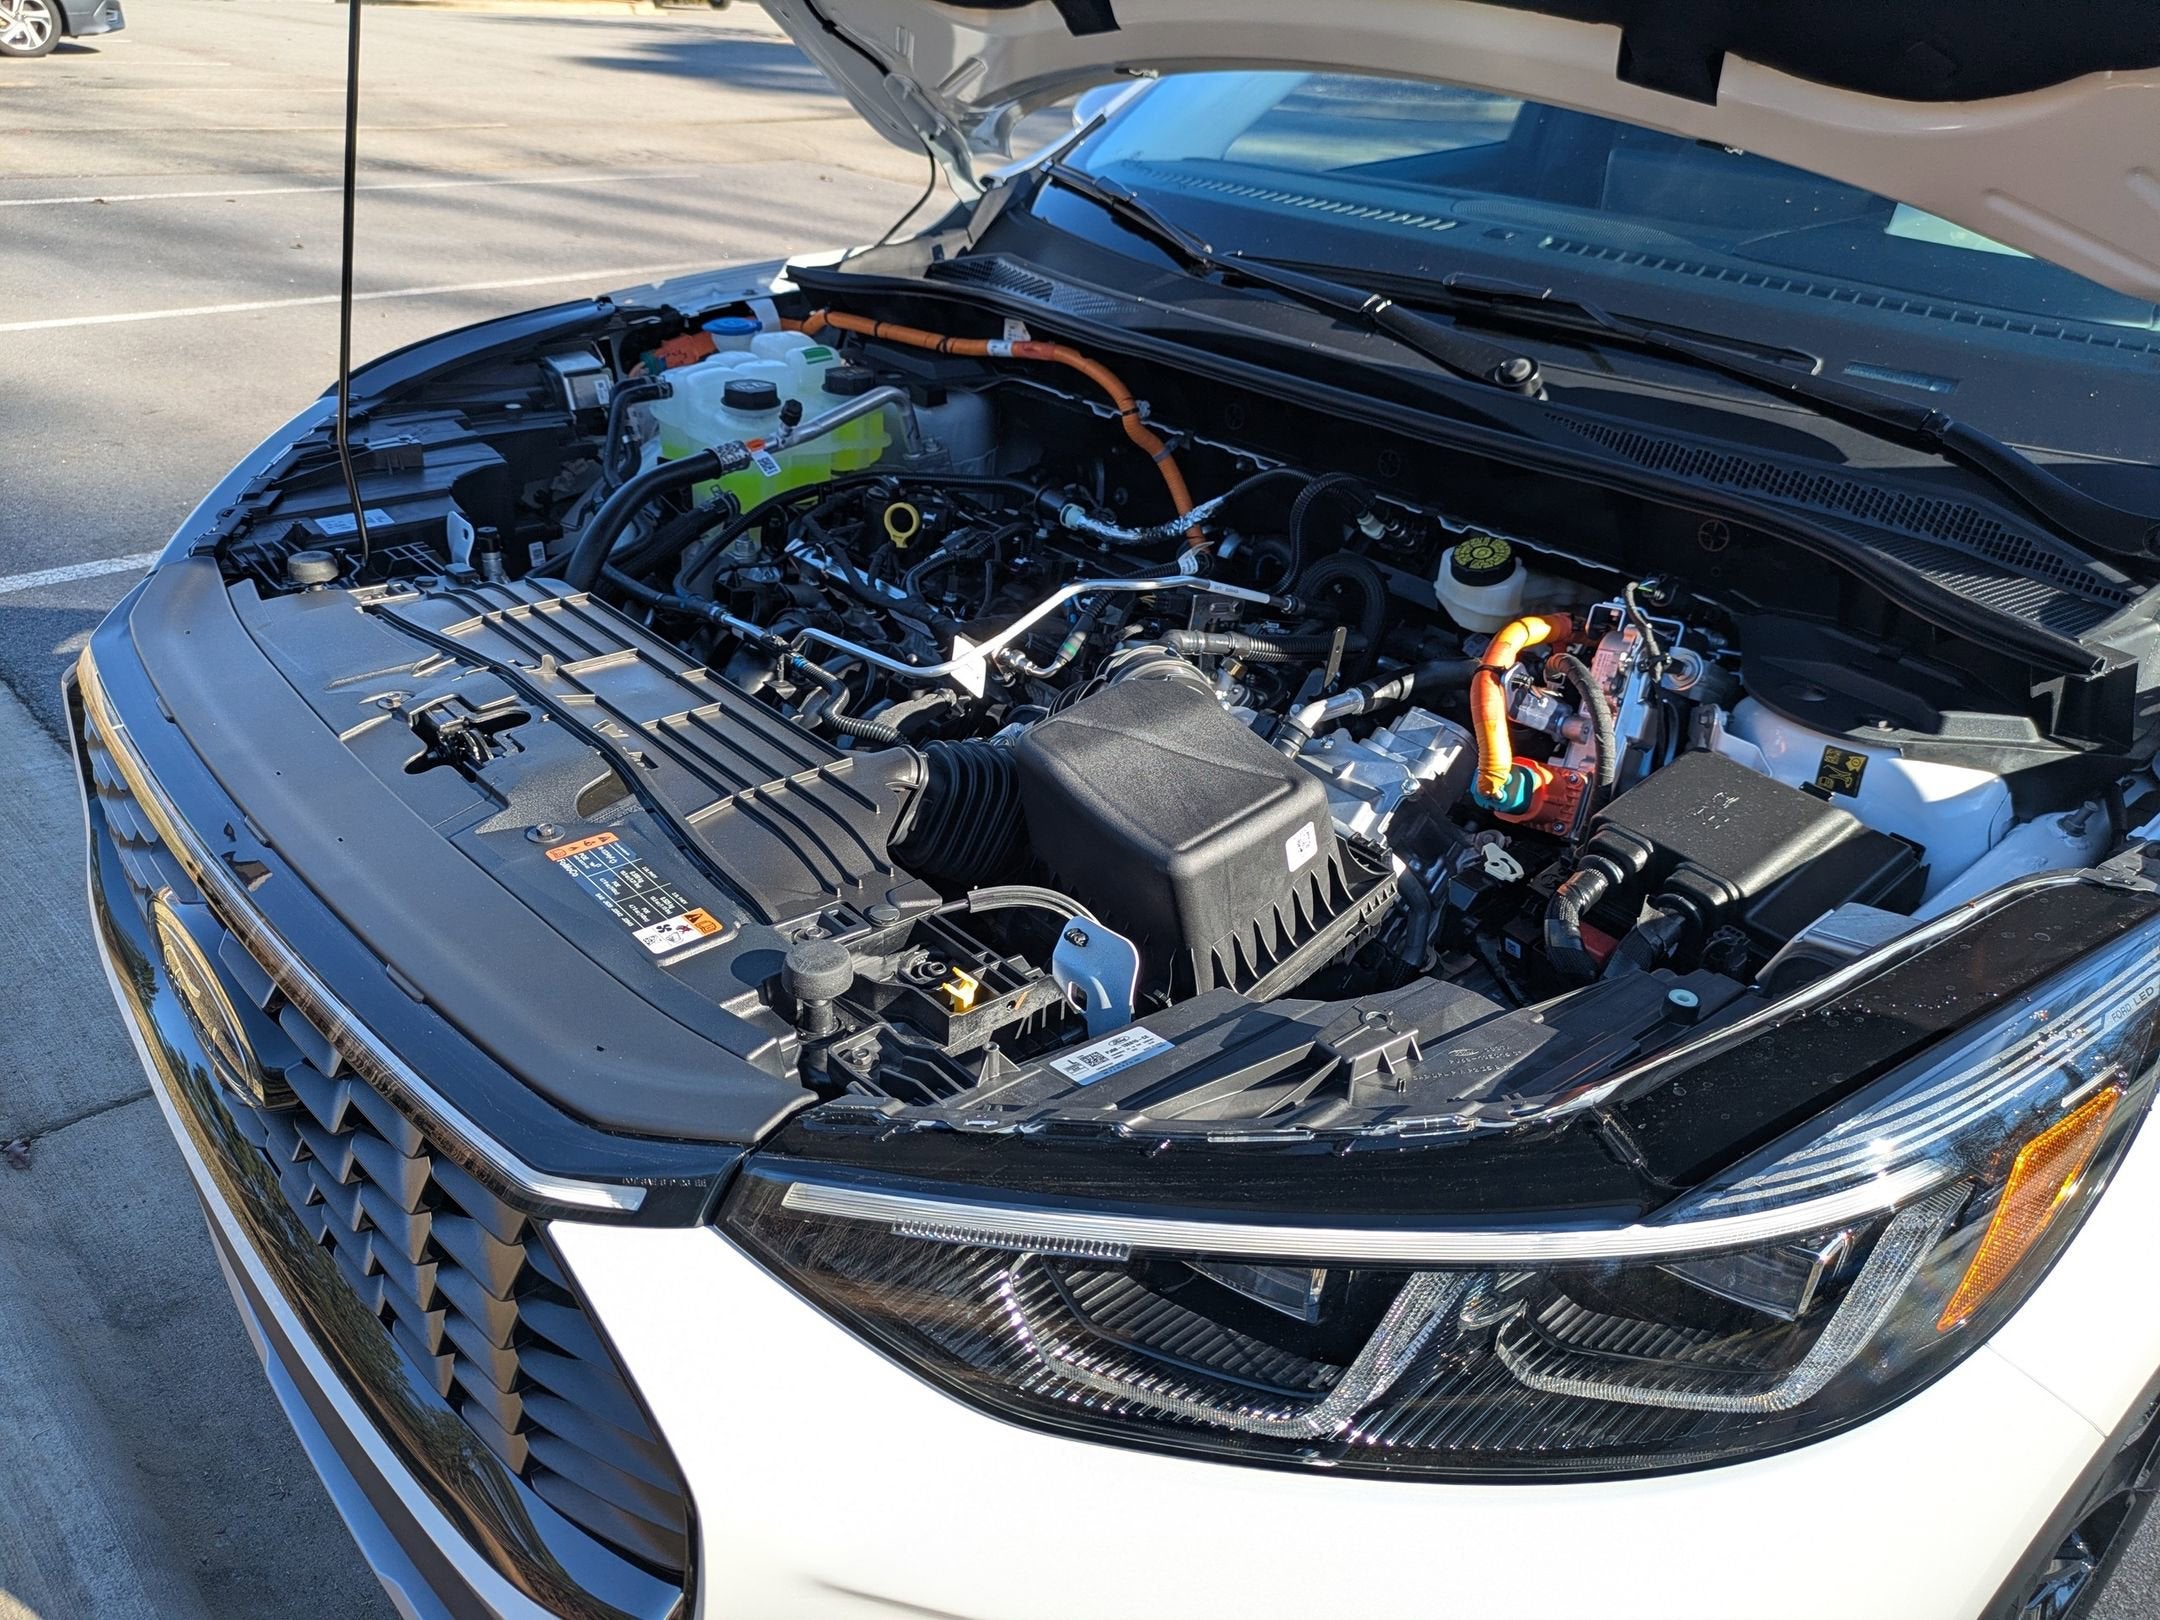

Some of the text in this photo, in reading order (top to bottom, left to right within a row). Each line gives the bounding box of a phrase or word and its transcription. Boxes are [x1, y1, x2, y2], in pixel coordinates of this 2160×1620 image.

[557, 859, 579, 877] FoMoCo
[2111, 986, 2154, 1022] FORD LED
